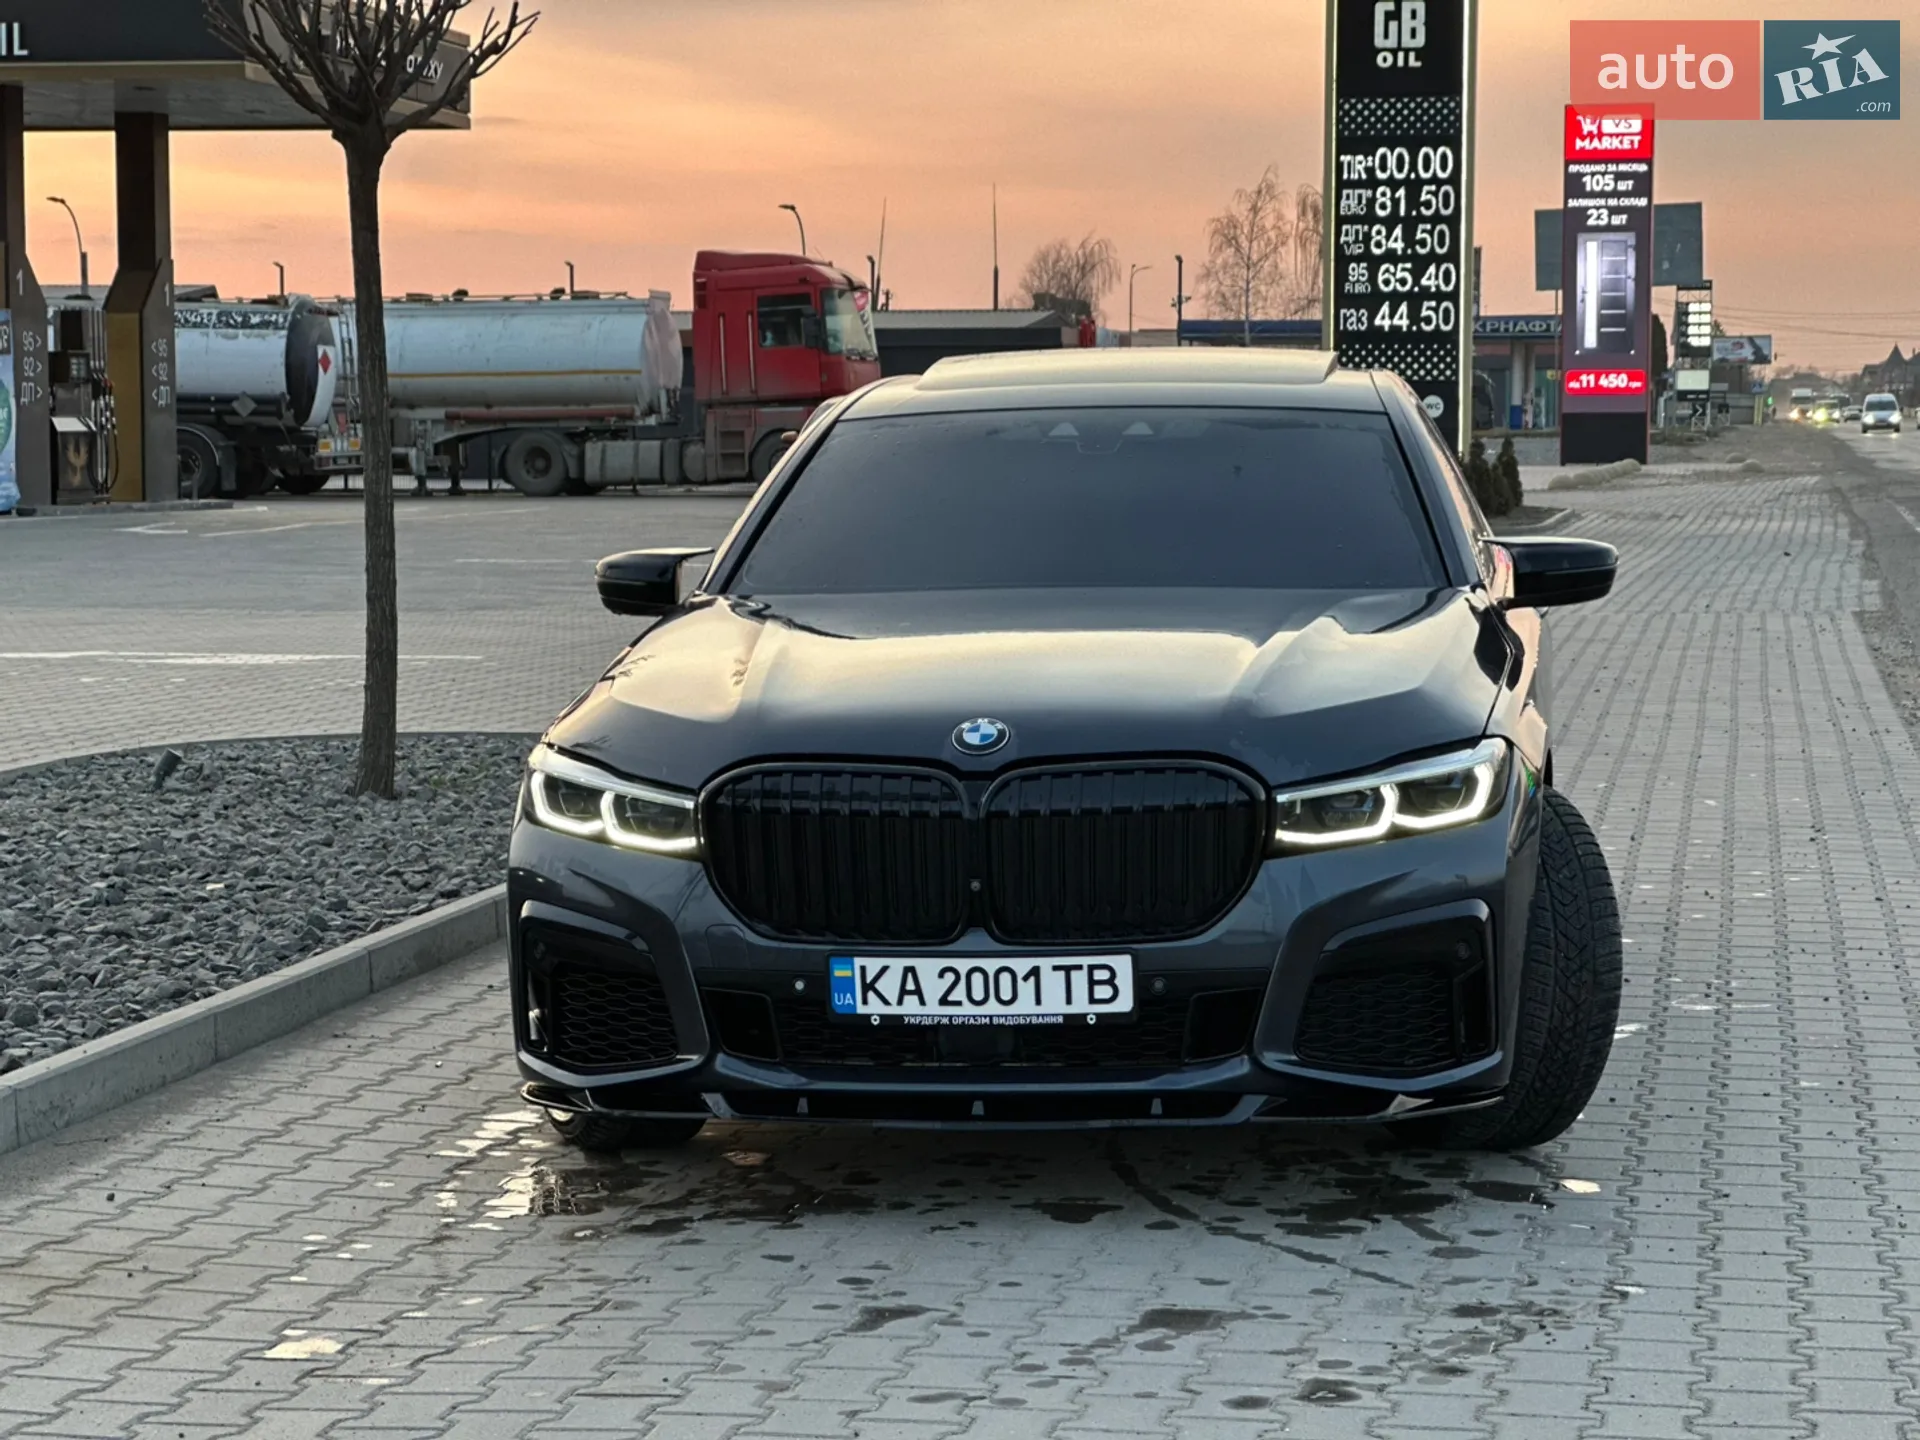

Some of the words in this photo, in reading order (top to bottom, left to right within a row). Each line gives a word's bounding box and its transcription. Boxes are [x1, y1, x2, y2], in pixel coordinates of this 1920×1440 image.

[1373, 1, 1426, 49] GB
[1376, 51, 1422, 68] OIL
[1575, 135, 1642, 151] MARKET
[1374, 146, 1454, 180] 00.00
[1582, 173, 1615, 192] 105
[1374, 185, 1455, 217] 81.50
[1586, 208, 1609, 226] 23
[1370, 224, 1450, 255] 84.50
[1348, 262, 1369, 282] 95
[1377, 263, 1457, 292] 65.40
[1374, 301, 1456, 331] 44.50
[834, 993, 855, 1006] UA
[937, 965, 1042, 1007] 2001
[903, 1016, 950, 1026] УКРДЕРЖ
[952, 1016, 990, 1025] ОРГАЗМ
[992, 1015, 1064, 1025] ВИДОБУВАННЯ
